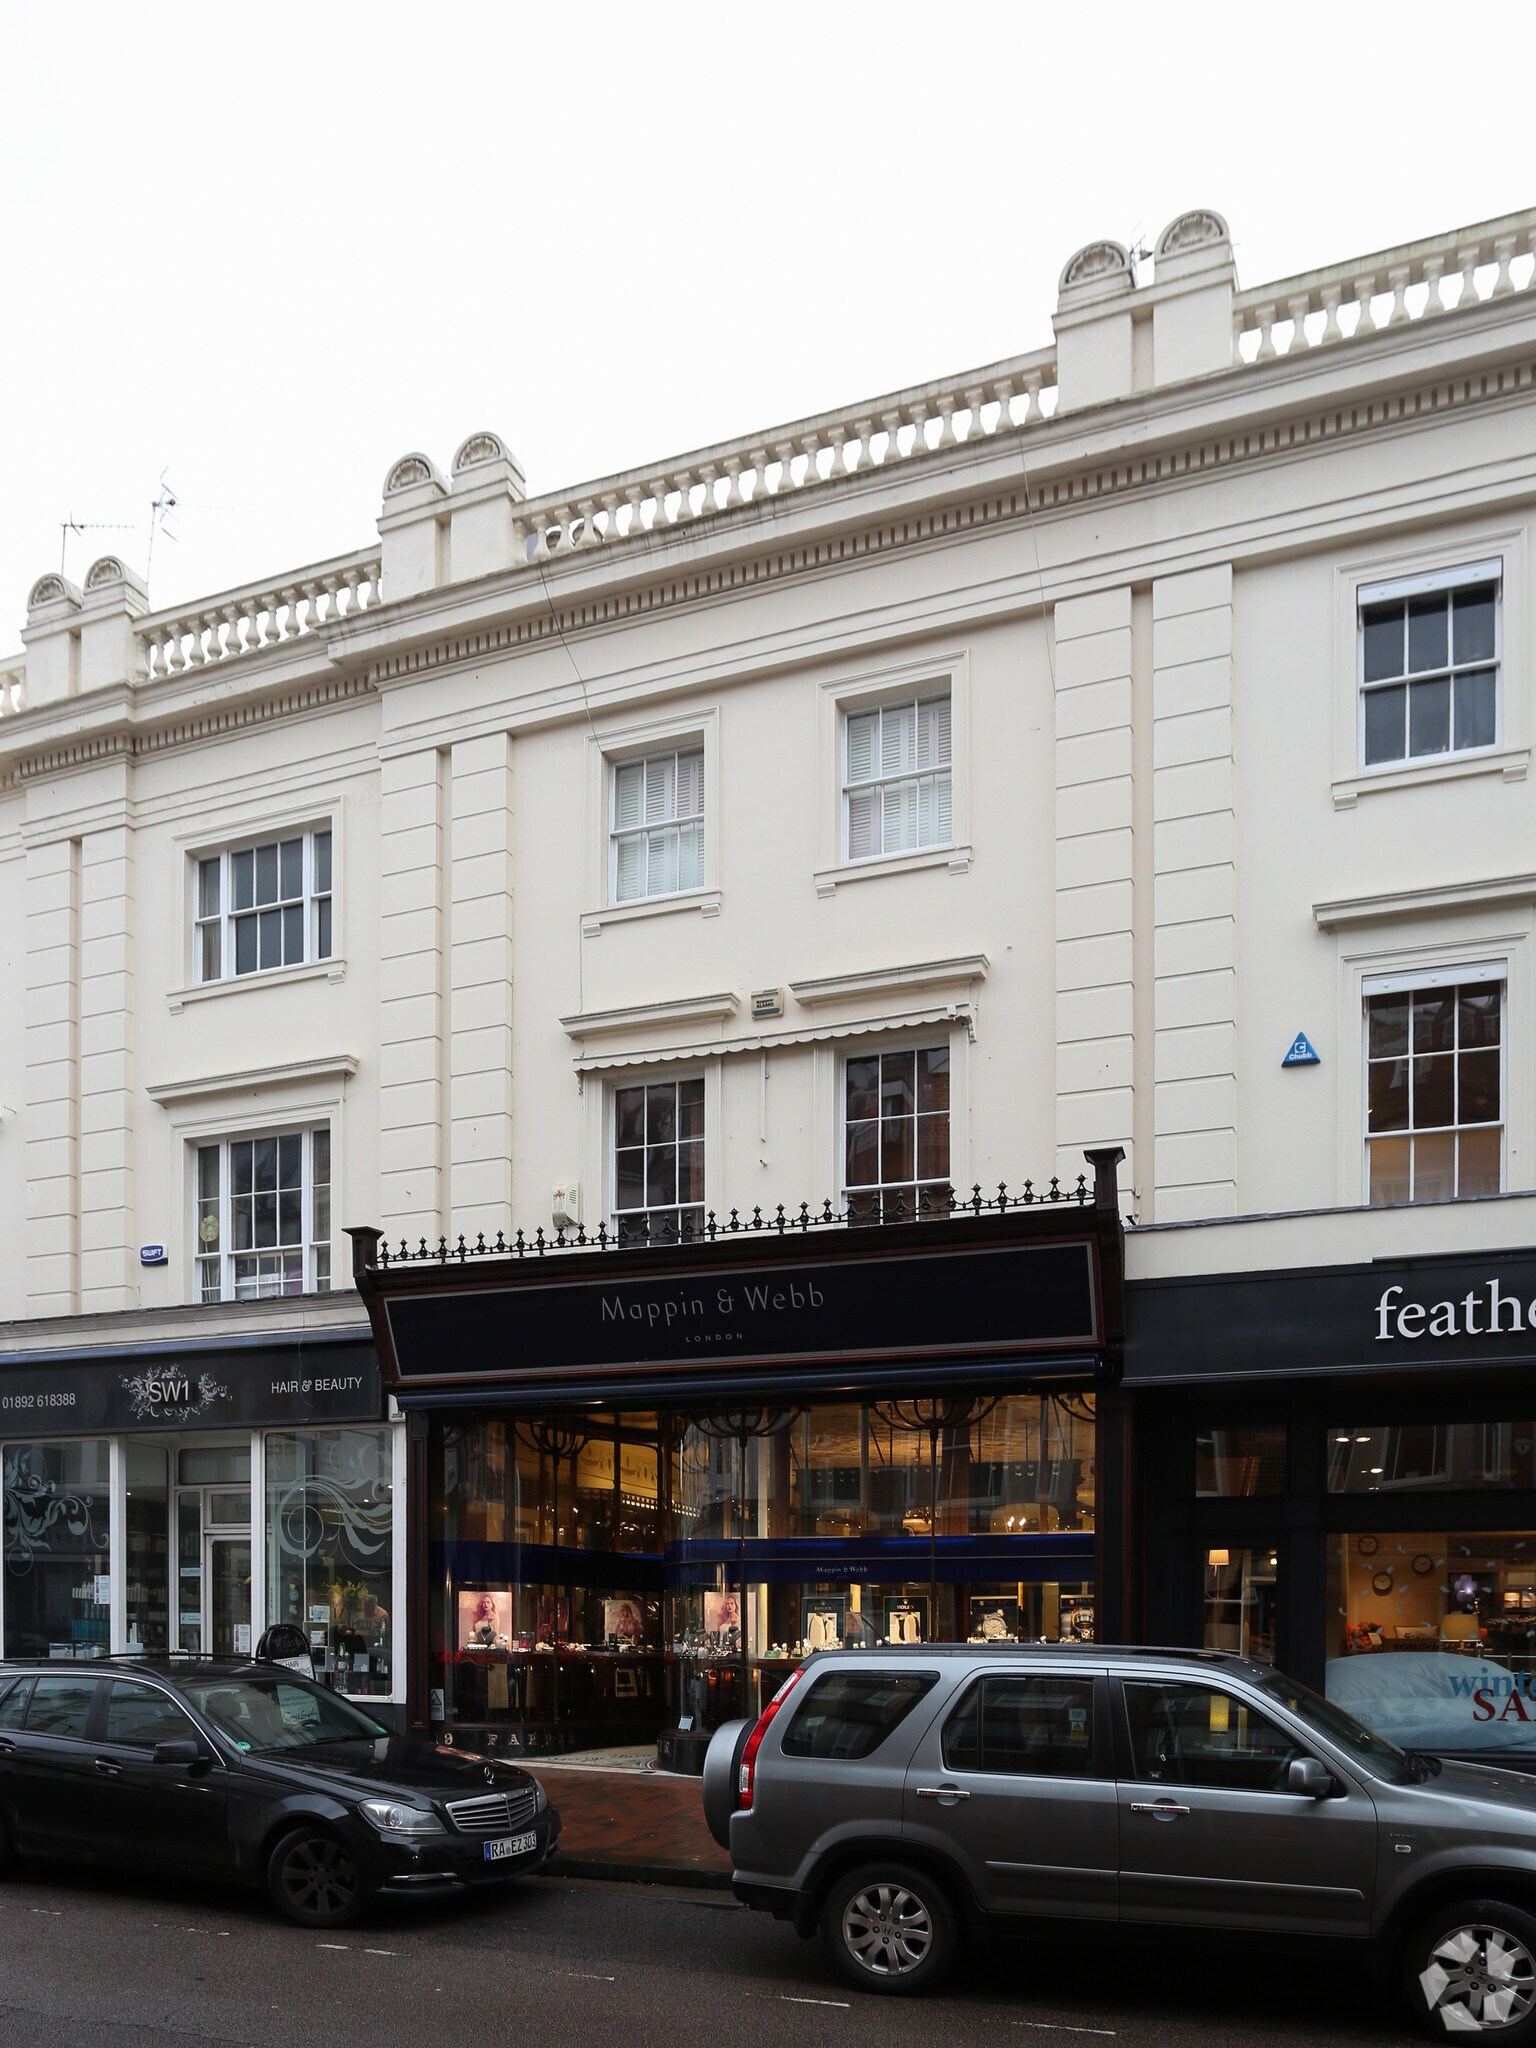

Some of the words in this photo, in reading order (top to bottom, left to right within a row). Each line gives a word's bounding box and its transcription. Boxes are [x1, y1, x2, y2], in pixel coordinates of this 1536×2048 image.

[1289, 1052, 1312, 1060] Chubb
[602, 1291, 704, 1328] Mappin
[717, 1289, 735, 1313] &
[744, 1282, 824, 1311] Webb
[685, 1333, 743, 1343] LONDON
[150, 1380, 189, 1403] SW1
[271, 1380, 299, 1394] HAIR
[301, 1379, 312, 1392] &
[314, 1376, 362, 1391] BEAUTY
[2, 1395, 34, 1409] 01892
[37, 1393, 76, 1407] 618388
[816, 1566, 842, 1574] Mappin
[1473, 1688, 1536, 1722] SA
[492, 1842, 506, 1858] RA
[511, 1839, 522, 1854] EZ
